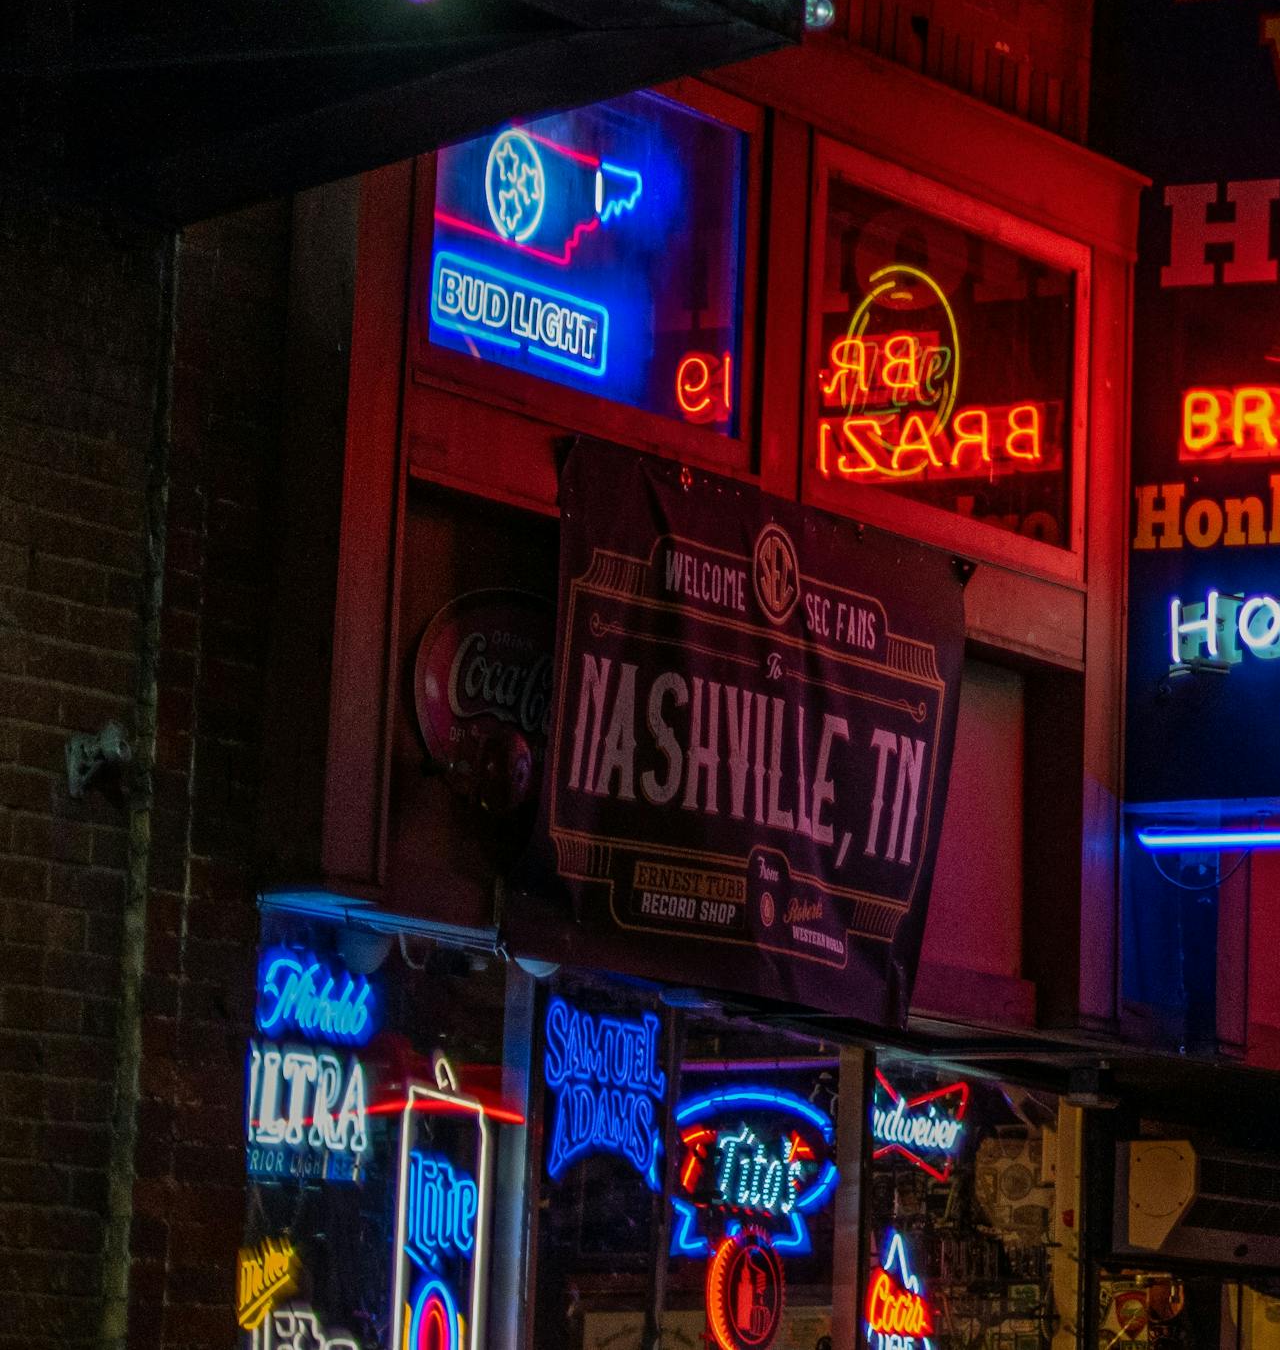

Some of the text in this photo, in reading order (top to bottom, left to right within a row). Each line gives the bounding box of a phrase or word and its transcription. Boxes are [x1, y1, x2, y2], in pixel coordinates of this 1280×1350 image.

[436, 267, 598, 362] BUD LIGHT
[664, 548, 747, 612] WELCOME
[759, 534, 793, 618] SEC
[805, 591, 877, 650] SEC FANS
[764, 651, 784, 680] To
[566, 650, 926, 868] NASHVILLE, TN
[636, 863, 745, 903] ERNEST TUBB
[641, 892, 737, 925] RECORD SHOP
[545, 998, 666, 1101] SAMUEL
[547, 1083, 664, 1185] ADAMS
